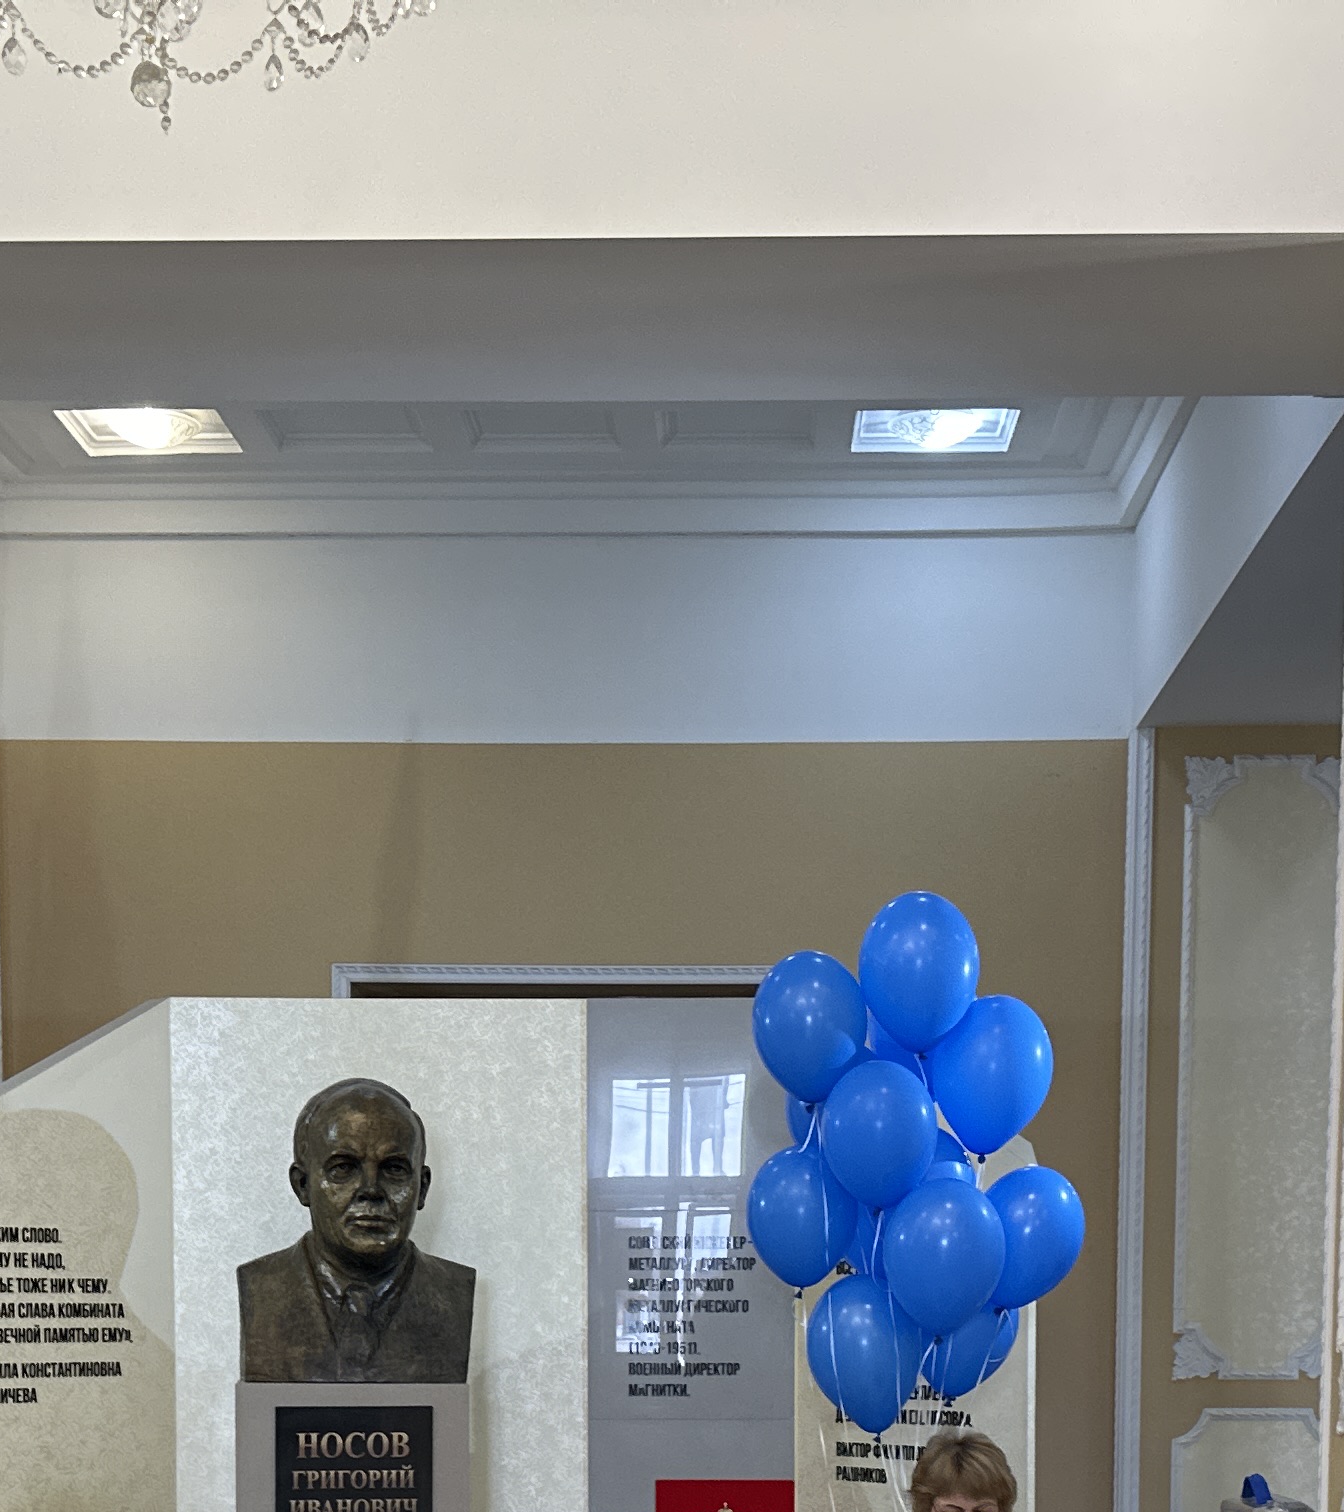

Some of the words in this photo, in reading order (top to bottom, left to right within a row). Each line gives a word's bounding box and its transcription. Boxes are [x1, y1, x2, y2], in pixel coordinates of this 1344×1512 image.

[14, 1252, 29, 1268] НЕ
[31, 1252, 66, 1270] НАДО,
[16, 1278, 48, 1294] ТОЖЕ
[18, 1302, 55, 1319] СЛАВА
[58, 1302, 125, 1319] КОМБИНАТА
[44, 1327, 99, 1344] ПАМЯТЬЮ
[21, 1361, 122, 1379] КОНСТАНТИНОВНА
[628, 1361, 682, 1376] ВОЕННЫЙ
[683, 1362, 740, 1377] ДИРЕКТОР
[295, 1431, 410, 1459] НОСОВ
[291, 1464, 416, 1491] ГРИГОРИЙ
